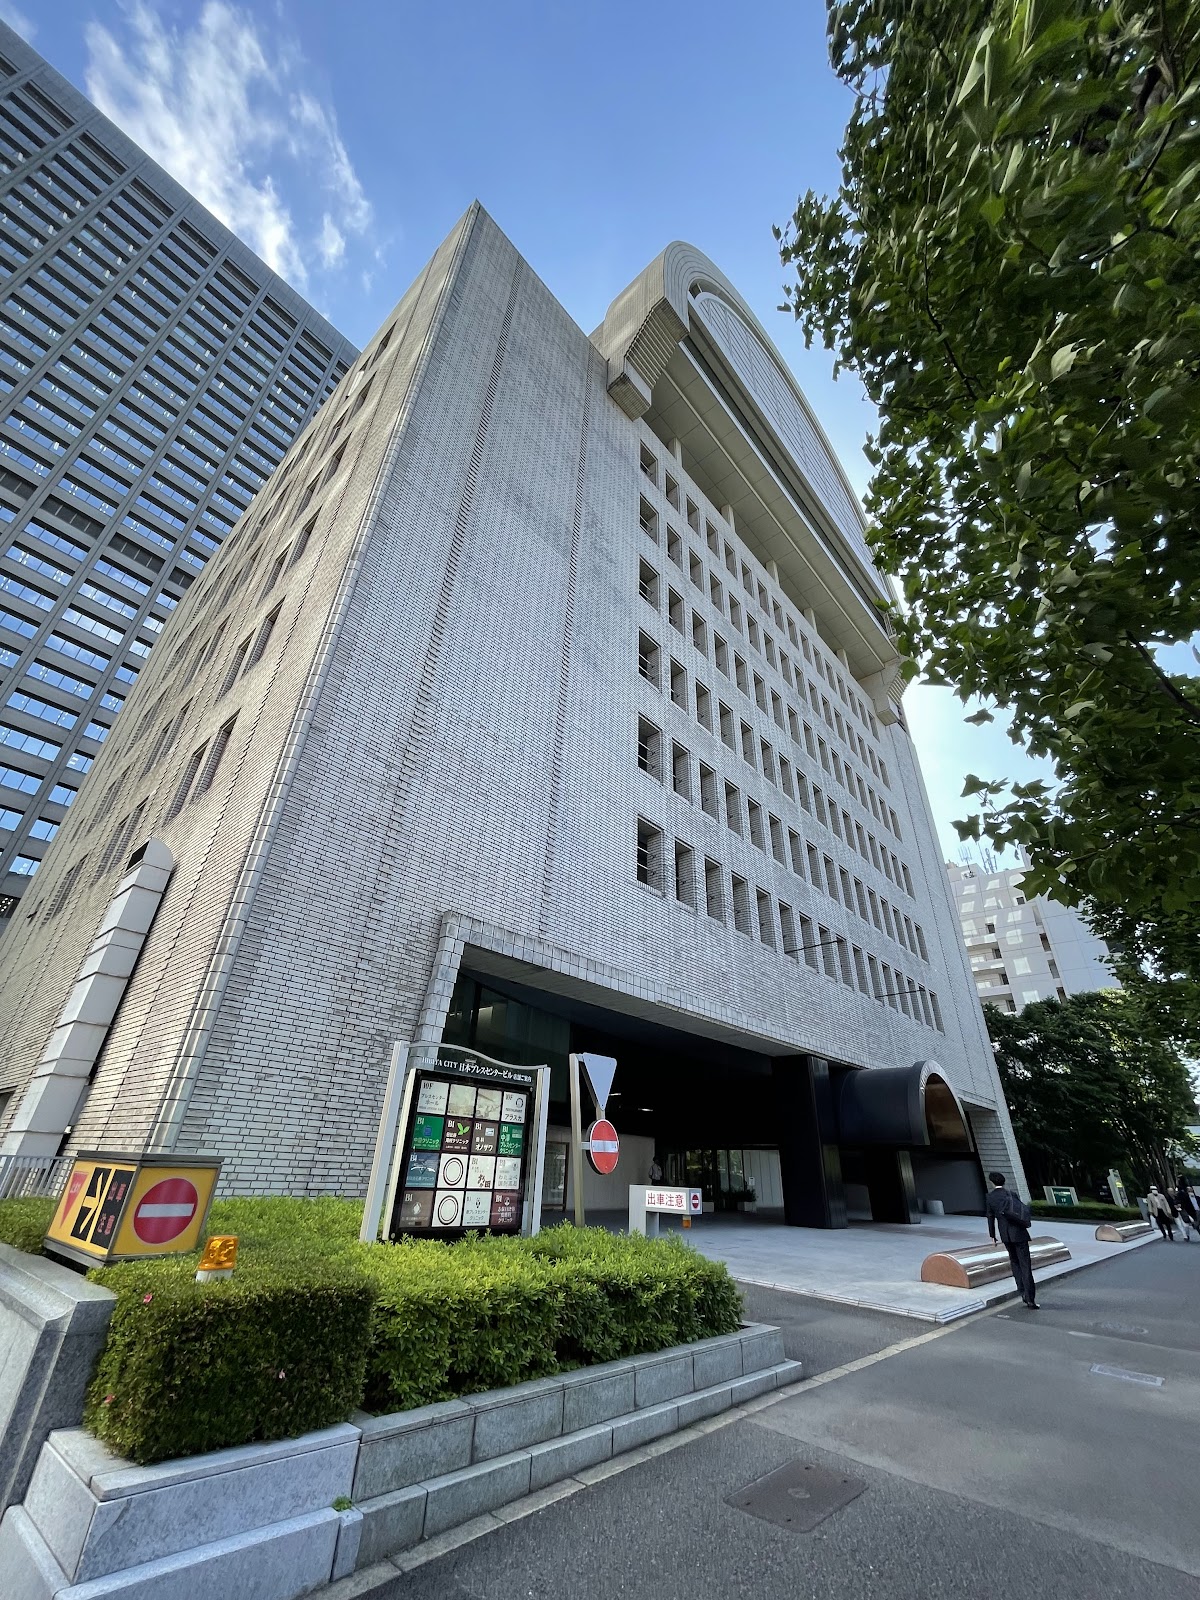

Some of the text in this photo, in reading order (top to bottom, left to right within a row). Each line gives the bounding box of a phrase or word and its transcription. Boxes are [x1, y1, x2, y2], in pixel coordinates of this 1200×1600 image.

[443, 1060, 459, 1069] CITY
[459, 1063, 513, 1079] 日本プレスセンタービル
[421, 1093, 446, 1101] プレスセンター
[504, 1113, 522, 1122] アラスカ
[647, 1192, 685, 1208] 出車注意
